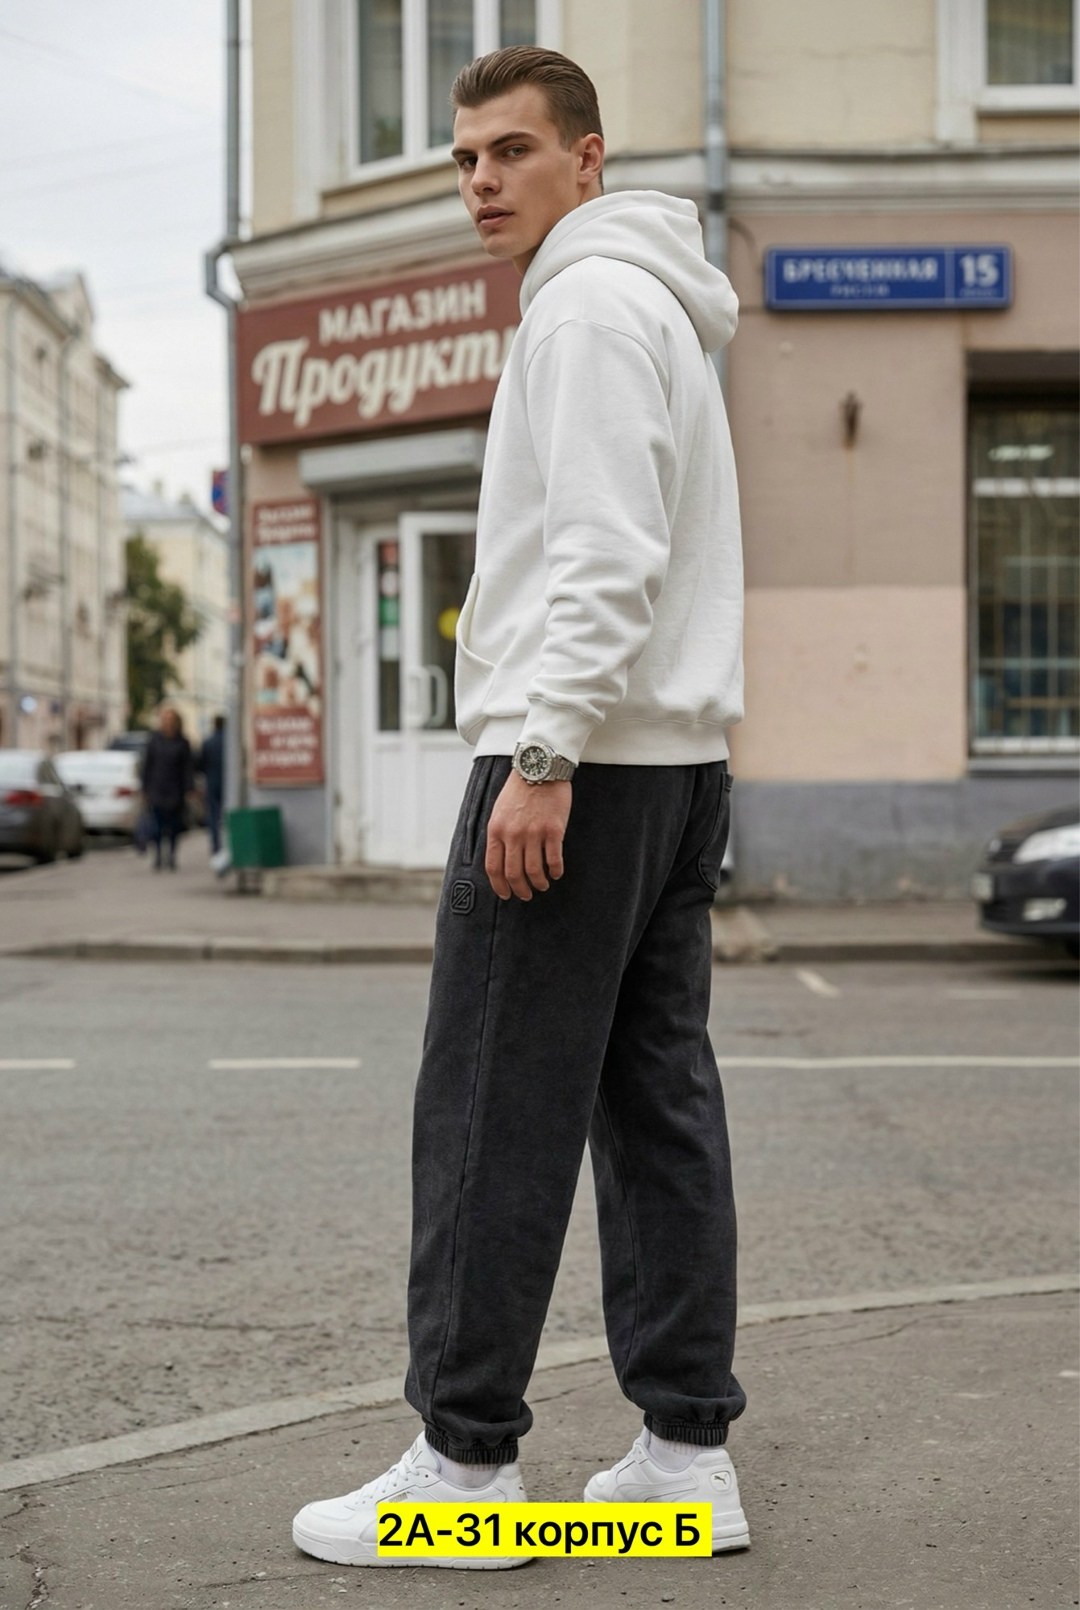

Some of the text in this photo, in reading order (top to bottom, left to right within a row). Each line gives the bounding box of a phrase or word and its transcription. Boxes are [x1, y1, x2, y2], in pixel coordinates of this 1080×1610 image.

[959, 254, 999, 288] 15
[318, 280, 487, 345] МАГАЗИН
[251, 327, 518, 428] Продукт
